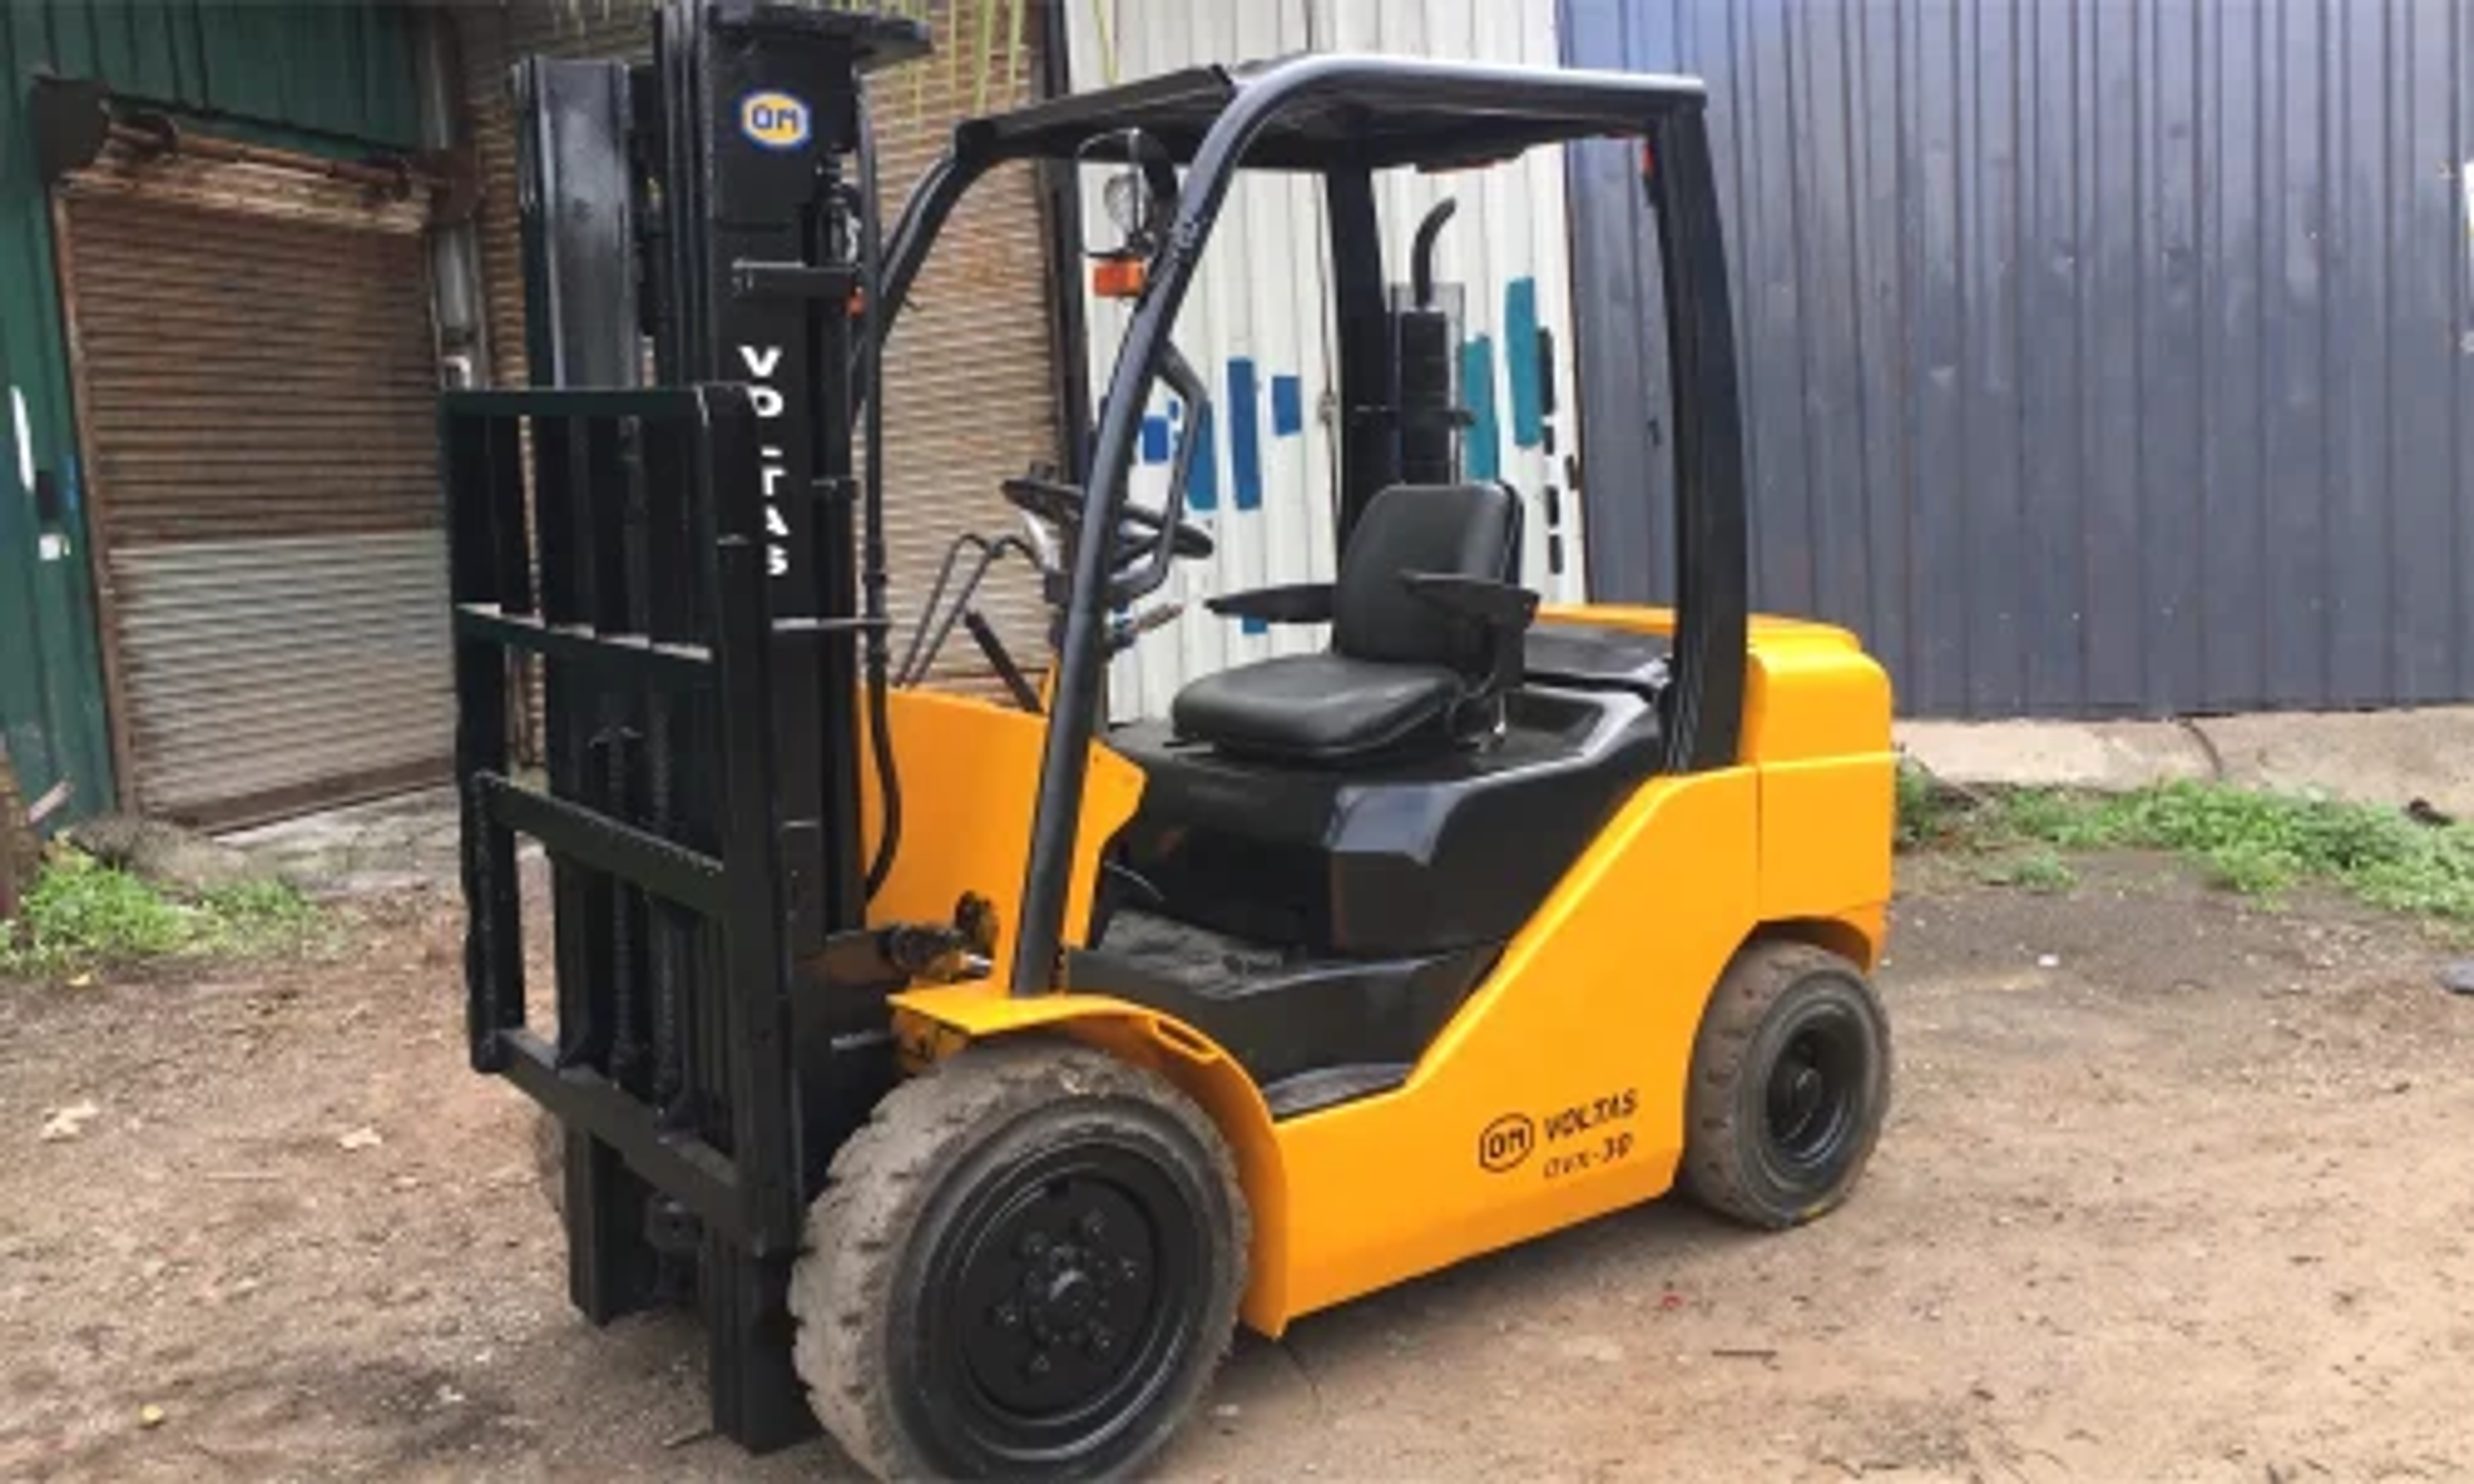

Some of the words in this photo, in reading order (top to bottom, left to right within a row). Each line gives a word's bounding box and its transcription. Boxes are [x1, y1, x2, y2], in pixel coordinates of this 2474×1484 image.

[752, 104, 798, 135] OM
[1488, 1127, 1526, 1159] OM
[1544, 1087, 1638, 1140] VOLTAS
